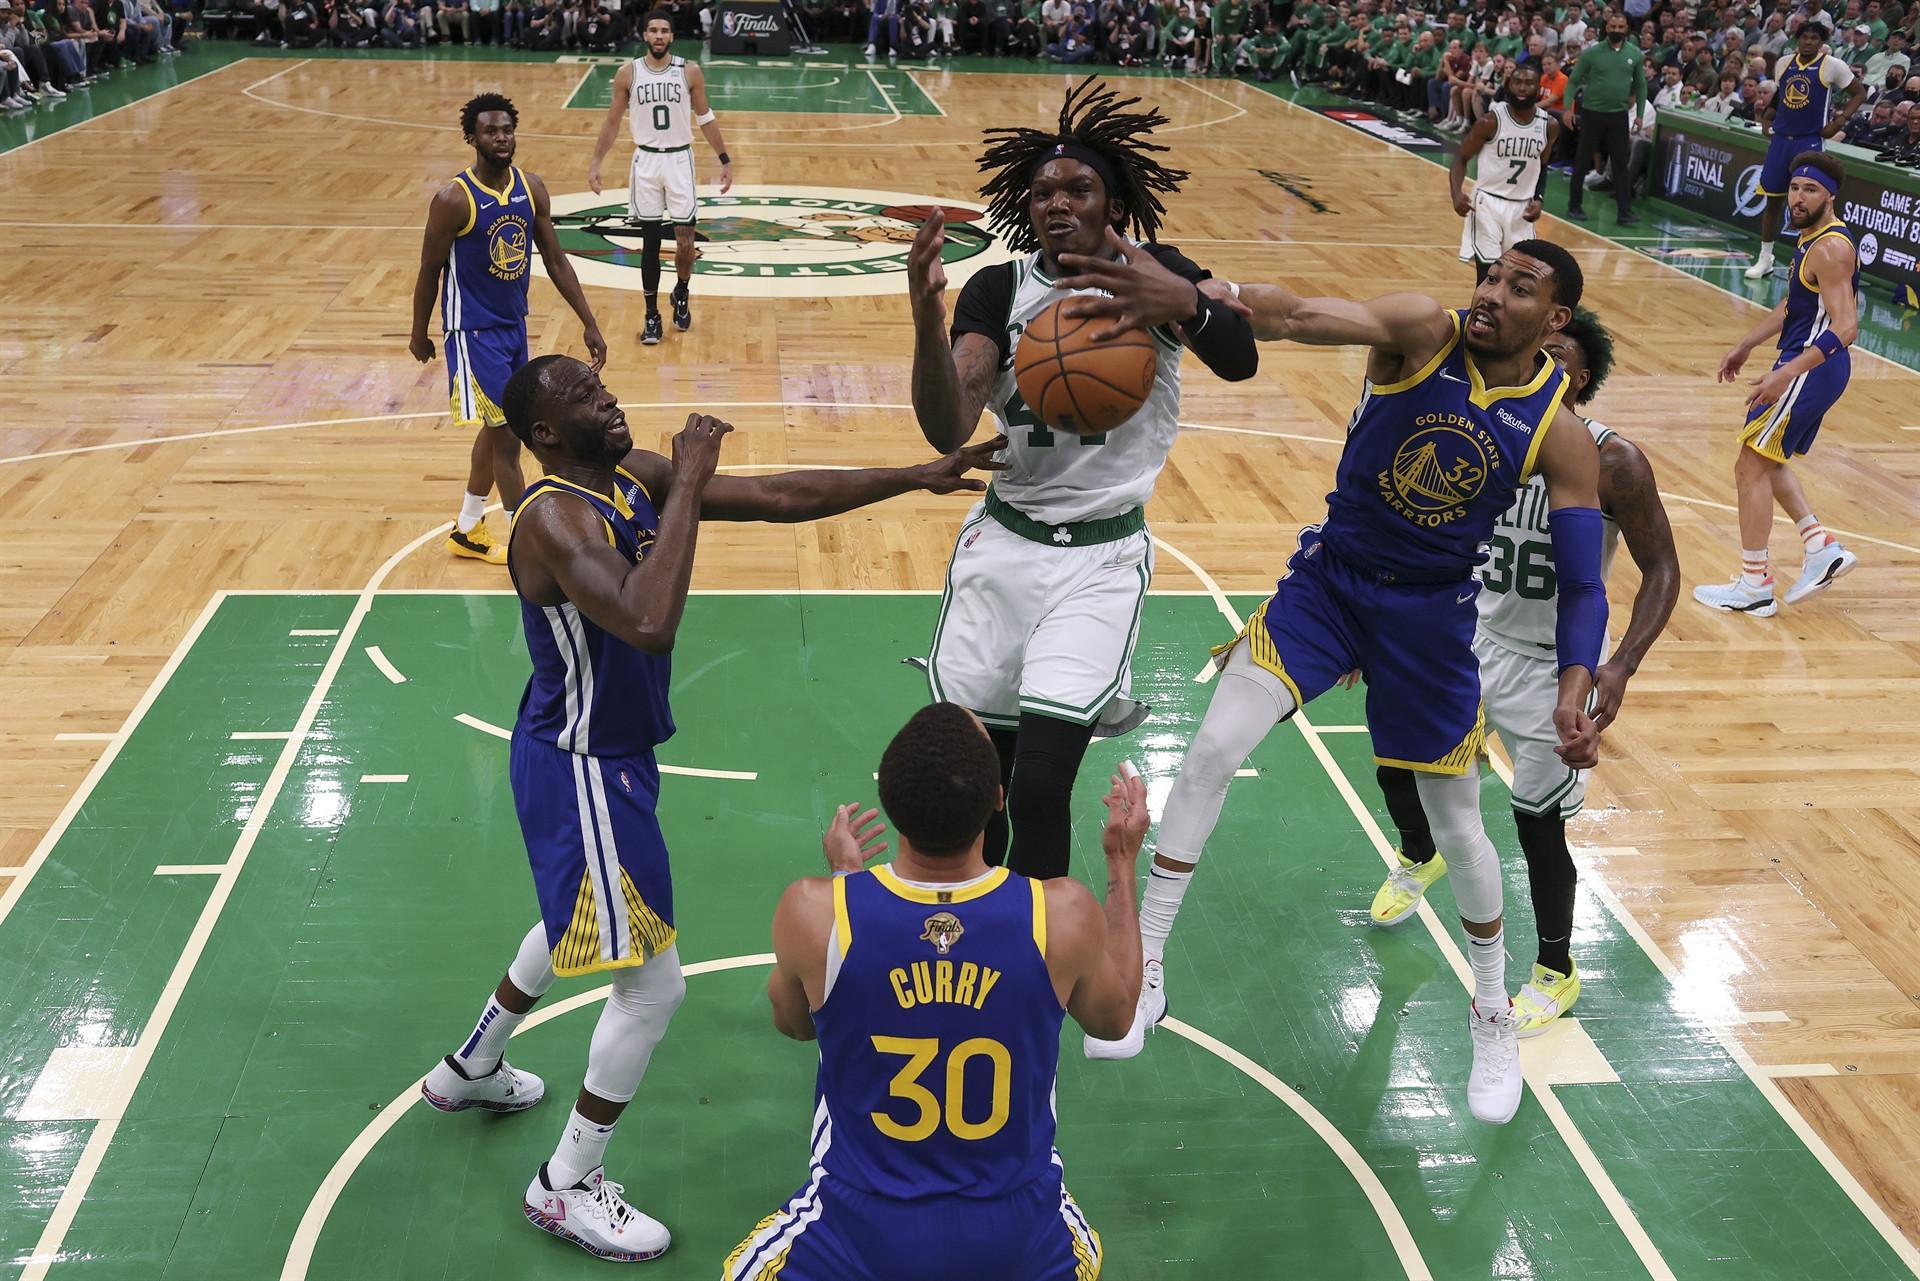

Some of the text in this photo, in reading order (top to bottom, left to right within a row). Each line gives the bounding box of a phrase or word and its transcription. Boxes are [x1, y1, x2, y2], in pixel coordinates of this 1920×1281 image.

[729, 13, 779, 37] Finals
[637, 83, 681, 105] CELTICS
[653, 105, 670, 130] 0
[1497, 137, 1543, 159] CELTICS
[1690, 143, 1733, 165] STANLEY CUP
[1506, 160, 1527, 184] 7
[1686, 155, 1725, 188] FINAL
[1881, 190, 1912, 215] GAME
[487, 214, 528, 236] GOLDEN STATE
[1843, 201, 1910, 239] SATURDAY
[512, 232, 525, 247] 22
[1496, 407, 1532, 436] Rakuten
[1416, 413, 1500, 470] GOLDEN STATE
[1445, 456, 1482, 492] 32
[1377, 469, 1467, 528] WARRIORS
[1481, 534, 1557, 600] 36
[920, 919, 961, 938] Finals
[889, 960, 1002, 1010] CURRY
[870, 1035, 1012, 1142] 30
